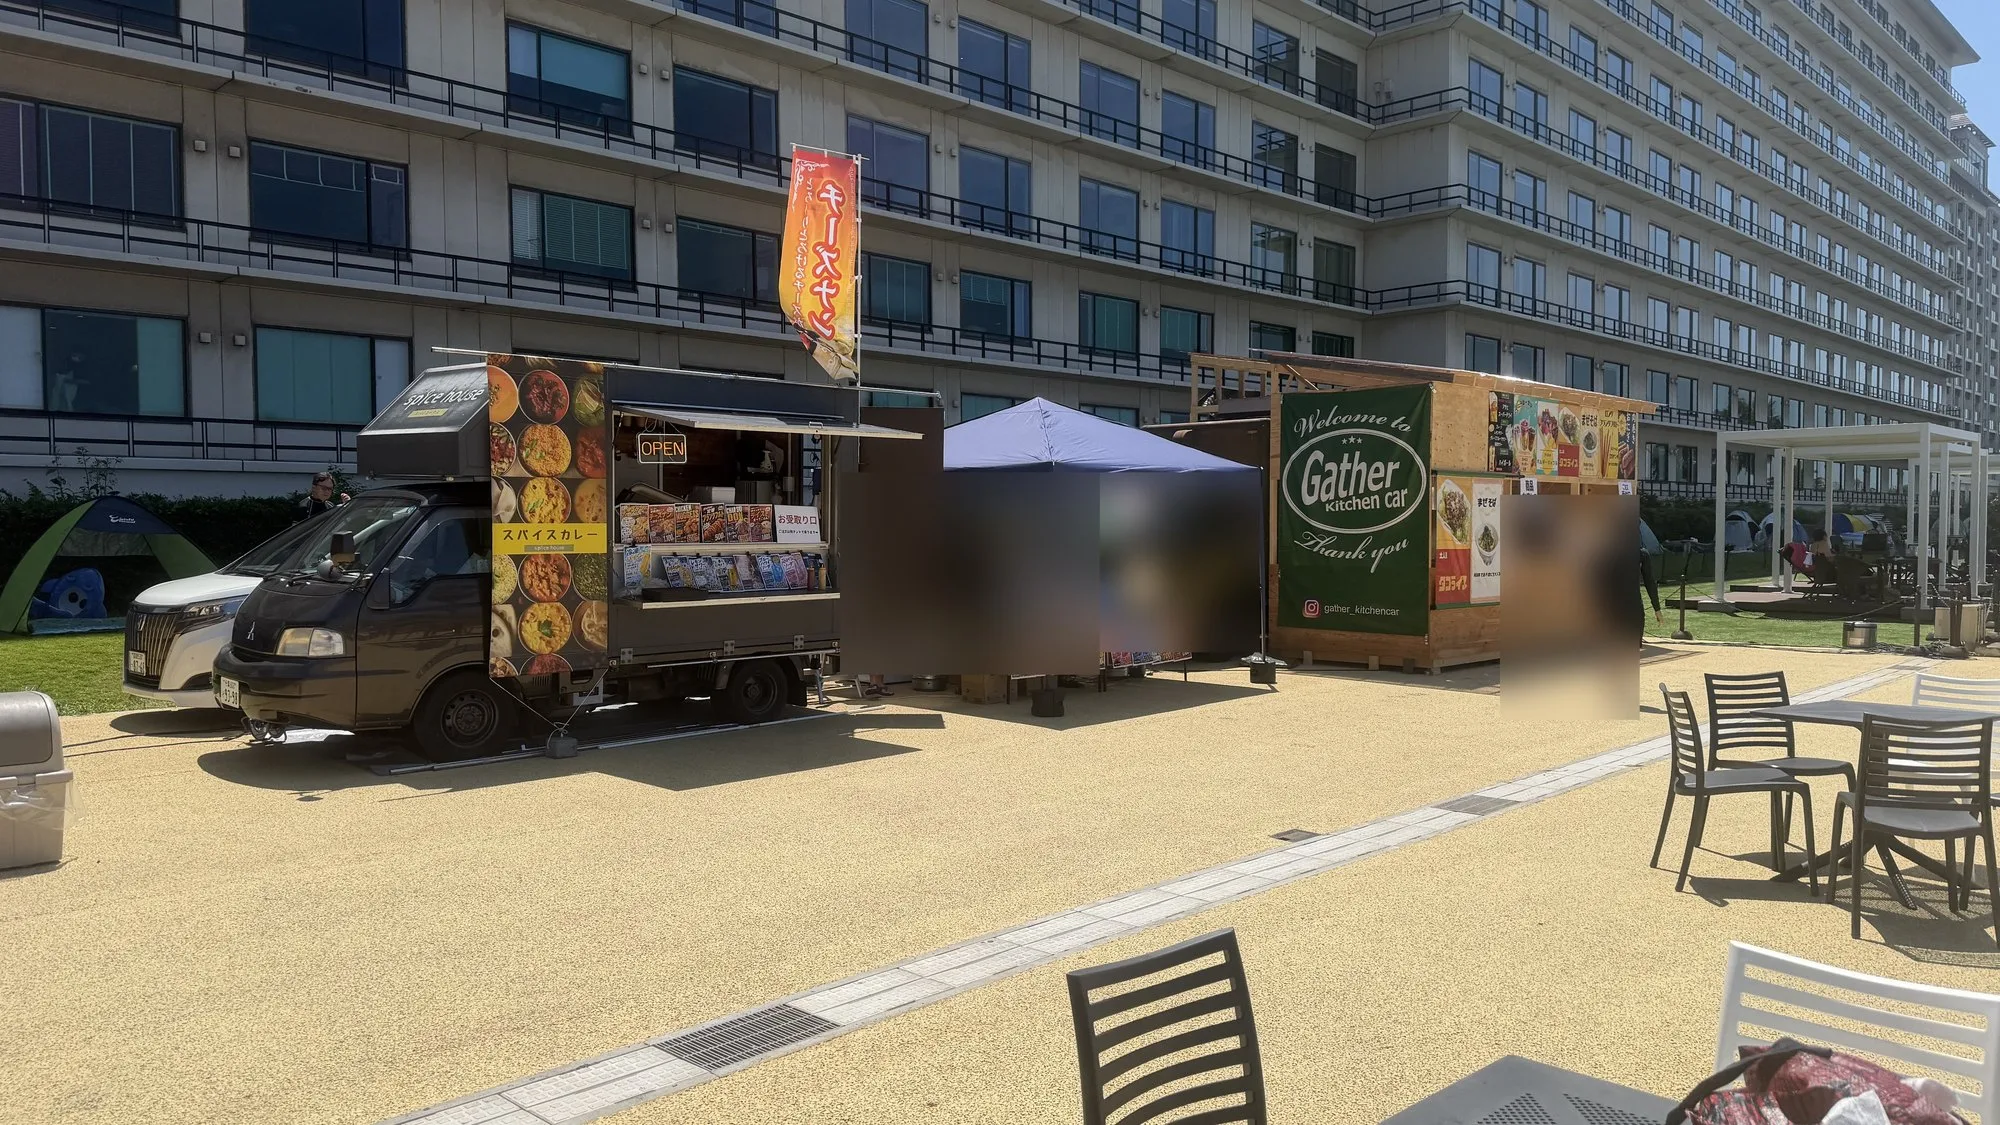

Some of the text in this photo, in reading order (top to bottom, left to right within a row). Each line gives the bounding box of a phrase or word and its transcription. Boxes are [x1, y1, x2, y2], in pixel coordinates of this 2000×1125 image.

[403, 386, 485, 411] spice house
[1293, 405, 1412, 438] Welcome to
[641, 441, 684, 456] OPEN
[1301, 449, 1401, 506] Gather
[1325, 488, 1408, 512] Kitchen car
[1477, 497, 1497, 508] まぜそば
[778, 514, 817, 525] お受取り口
[503, 529, 597, 541] スパイスカレー
[1293, 531, 1409, 573] Thank you
[1438, 575, 1468, 592] タコライス
[1324, 604, 1400, 616] gather_kitchencar
